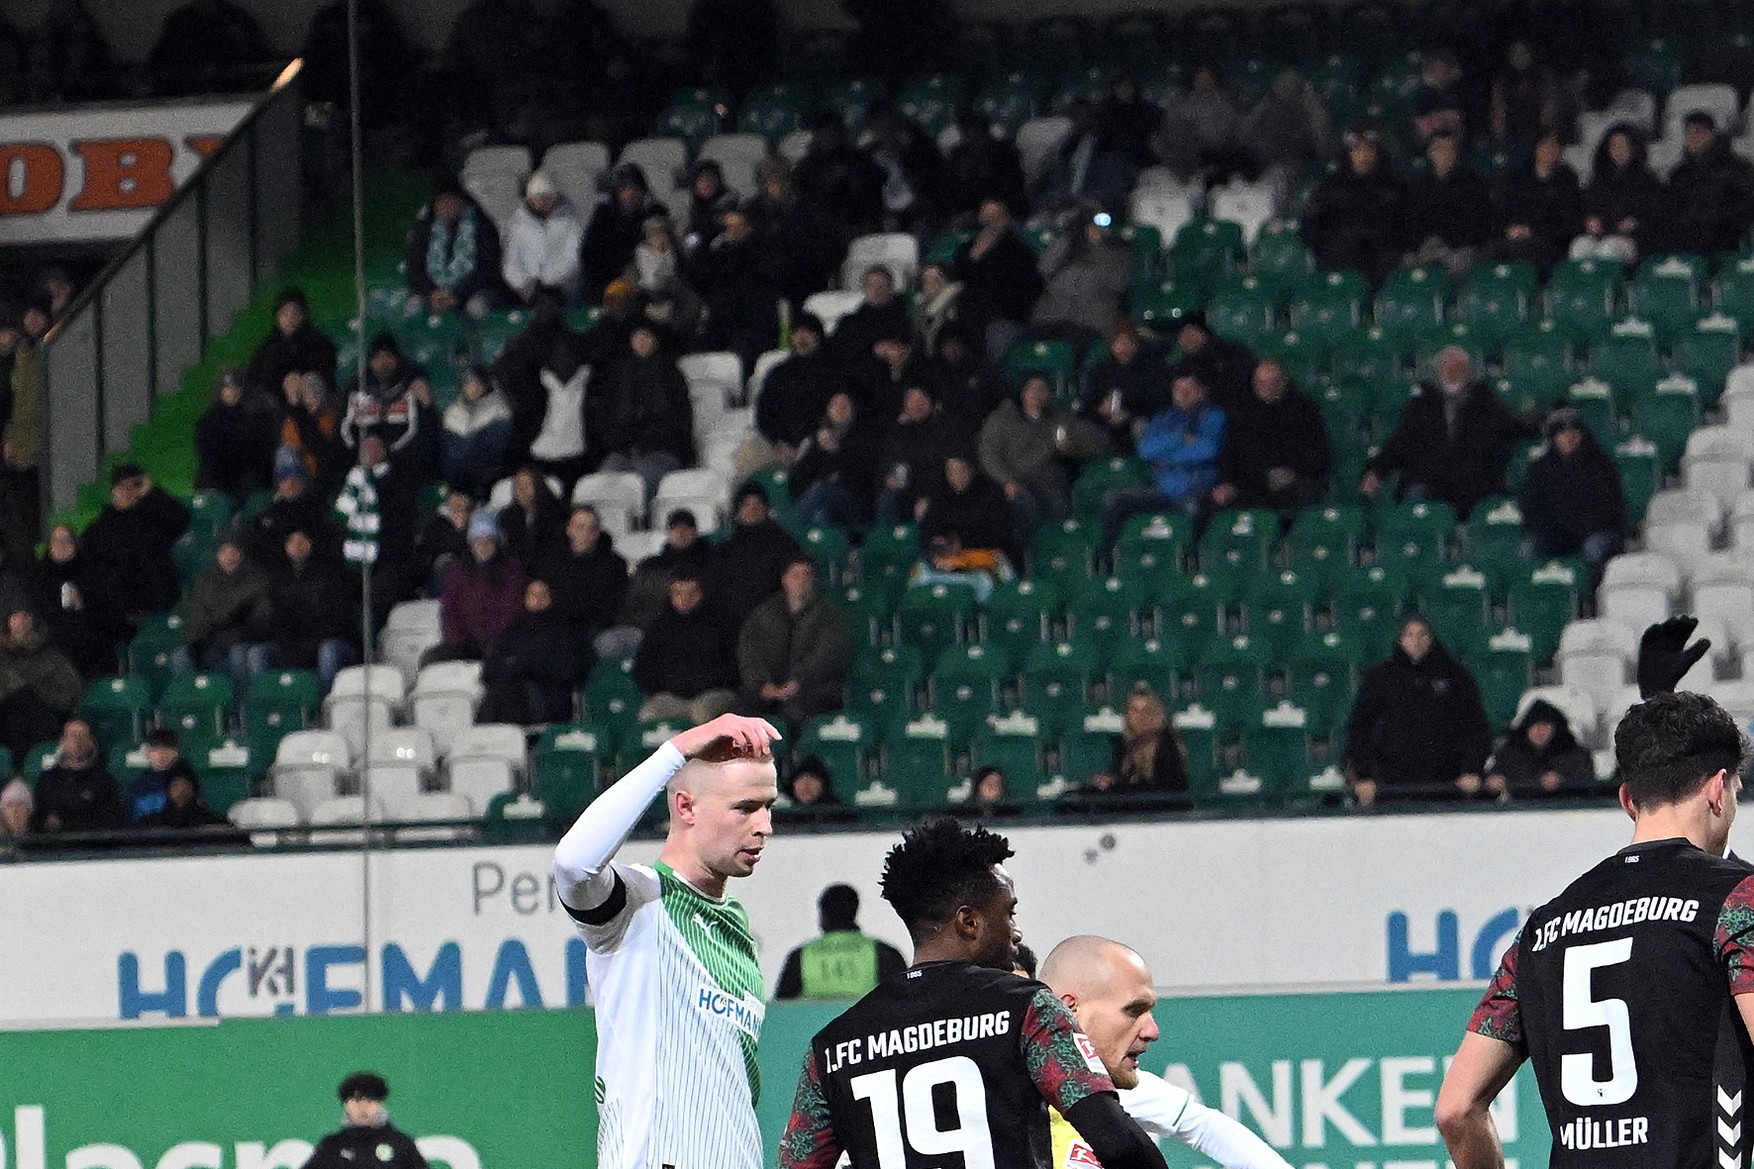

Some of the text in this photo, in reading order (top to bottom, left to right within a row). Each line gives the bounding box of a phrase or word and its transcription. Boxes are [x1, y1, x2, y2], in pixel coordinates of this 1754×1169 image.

[1561, 896, 1699, 937] MAGDEBURG
[825, 1010, 1010, 1074] 1.FC MAGDEBURG
[1561, 936, 1639, 1106] 5
[1560, 1116, 1649, 1151] MÜLLER
